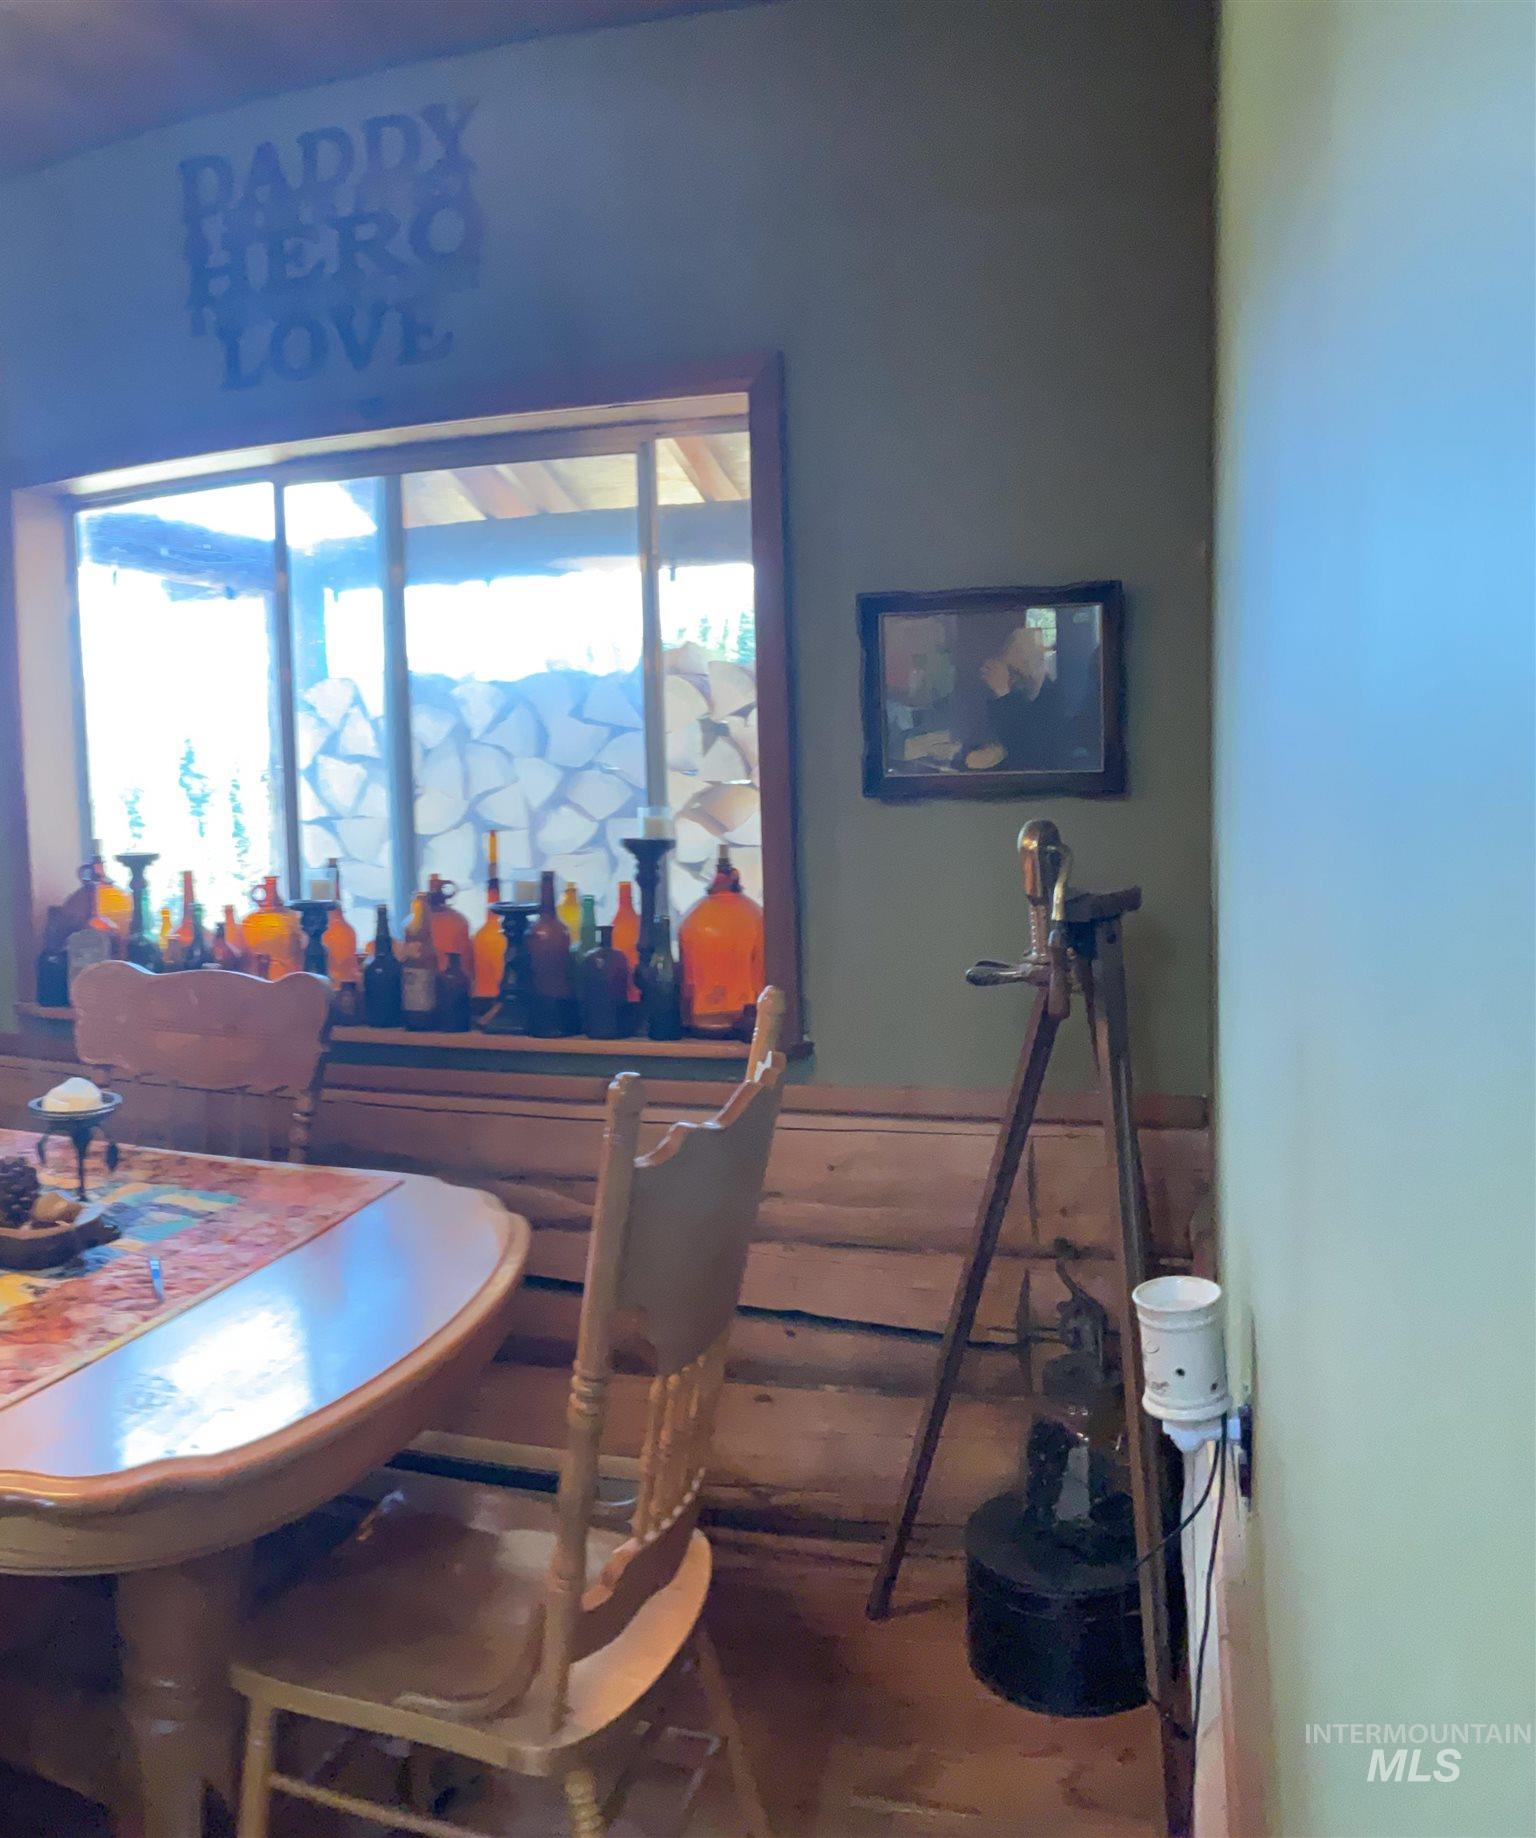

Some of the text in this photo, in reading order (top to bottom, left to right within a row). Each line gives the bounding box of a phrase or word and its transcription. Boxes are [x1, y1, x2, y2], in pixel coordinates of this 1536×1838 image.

[180, 100, 479, 212] DADDY
[185, 198, 481, 303] HERO
[217, 302, 454, 391] LOVE
